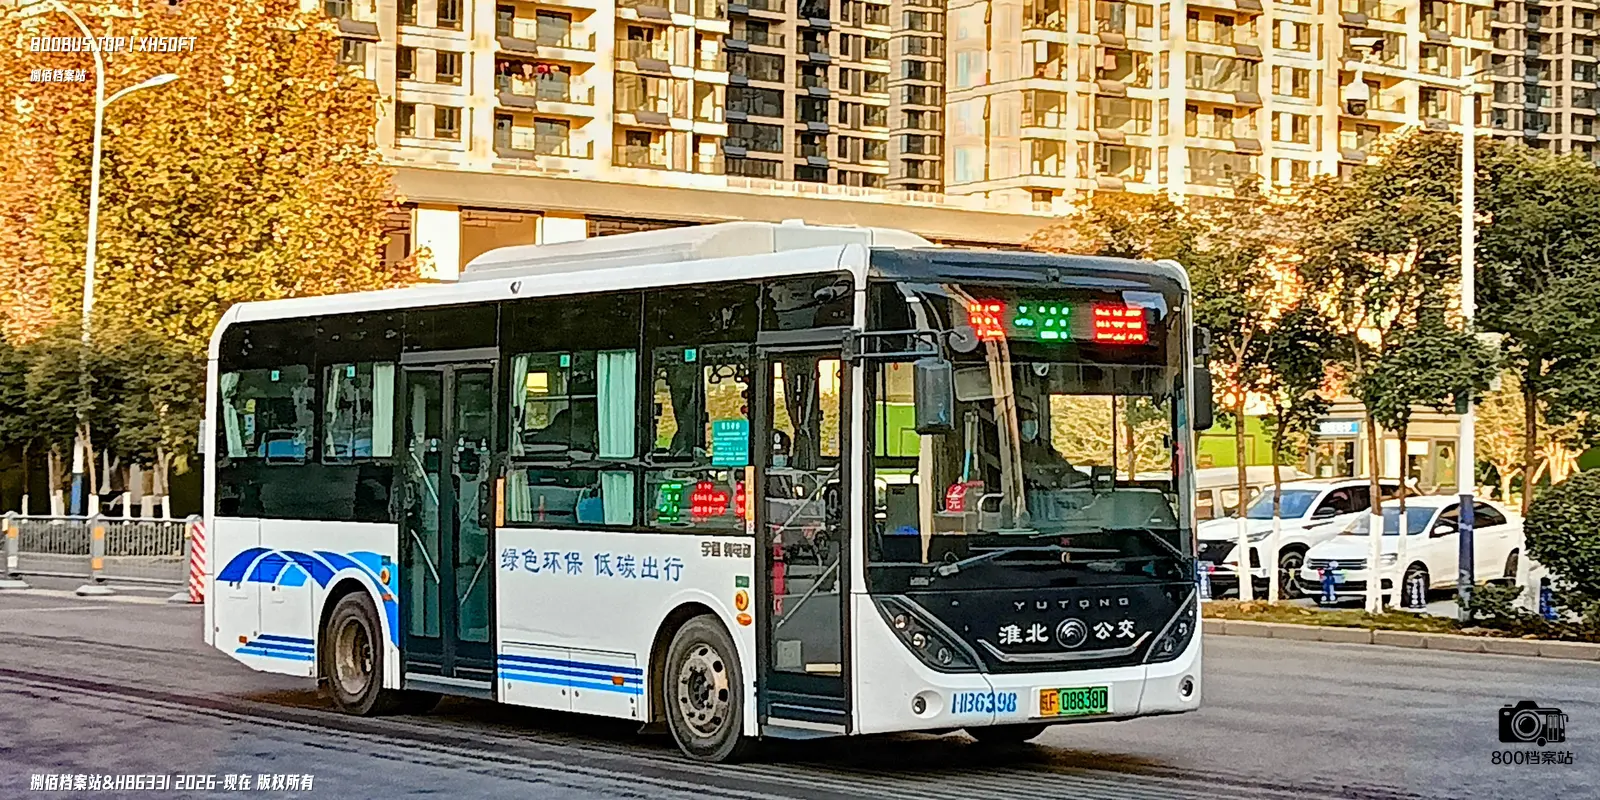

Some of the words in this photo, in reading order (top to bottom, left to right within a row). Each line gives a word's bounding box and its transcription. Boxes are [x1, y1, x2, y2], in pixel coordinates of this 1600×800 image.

[500, 547, 584, 576] 绿色环保
[593, 552, 685, 582] 低碳出行
[1013, 598, 1129, 610] YUTONG
[998, 622, 1049, 645] 淮北
[1092, 619, 1137, 640] 公交
[951, 692, 1018, 714] HB6398
[1040, 692, 1058, 711] F
